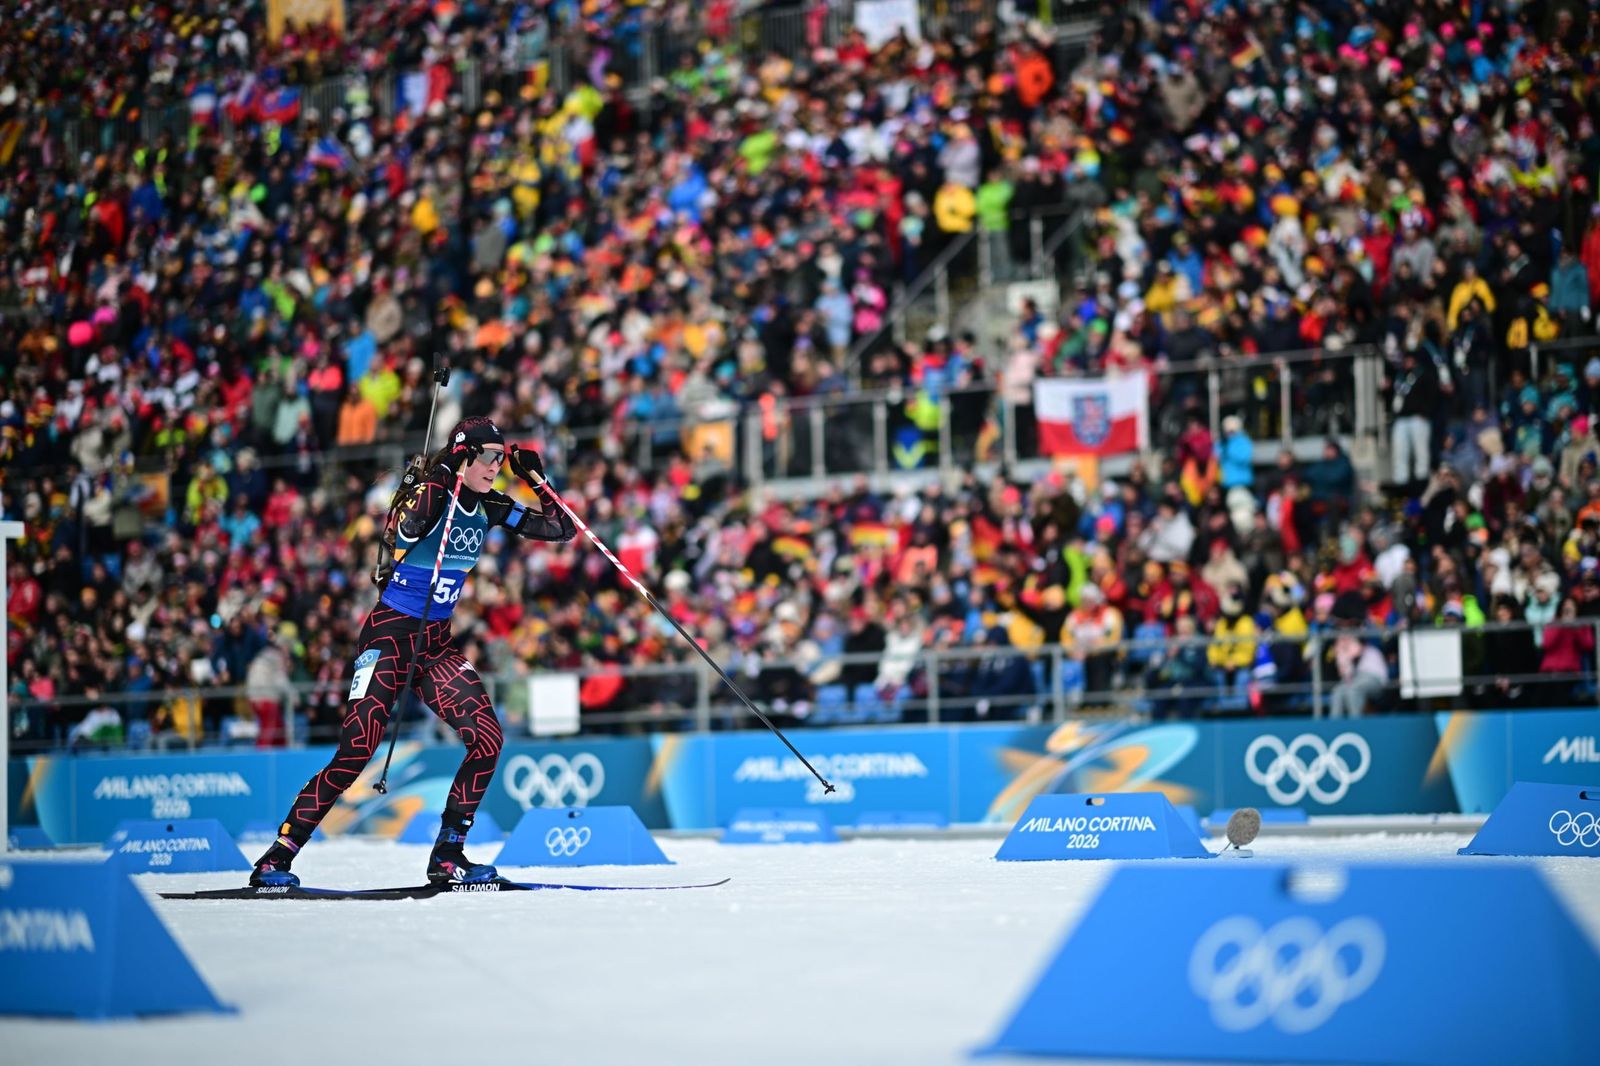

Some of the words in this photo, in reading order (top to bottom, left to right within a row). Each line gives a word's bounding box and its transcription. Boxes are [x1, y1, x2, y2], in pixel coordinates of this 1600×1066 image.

[829, 752, 928, 780] CORTINA
[94, 774, 170, 799] MILANO
[170, 772, 252, 797] CORTINA
[1019, 817, 1087, 832] MILANO
[1088, 816, 1157, 831] CORTINA
[119, 839, 167, 853] MILANO
[167, 837, 211, 851] CORTINA
[1066, 834, 1100, 848] 2026
[256, 886, 290, 894] SALOMON
[452, 883, 500, 892] SALOMON
